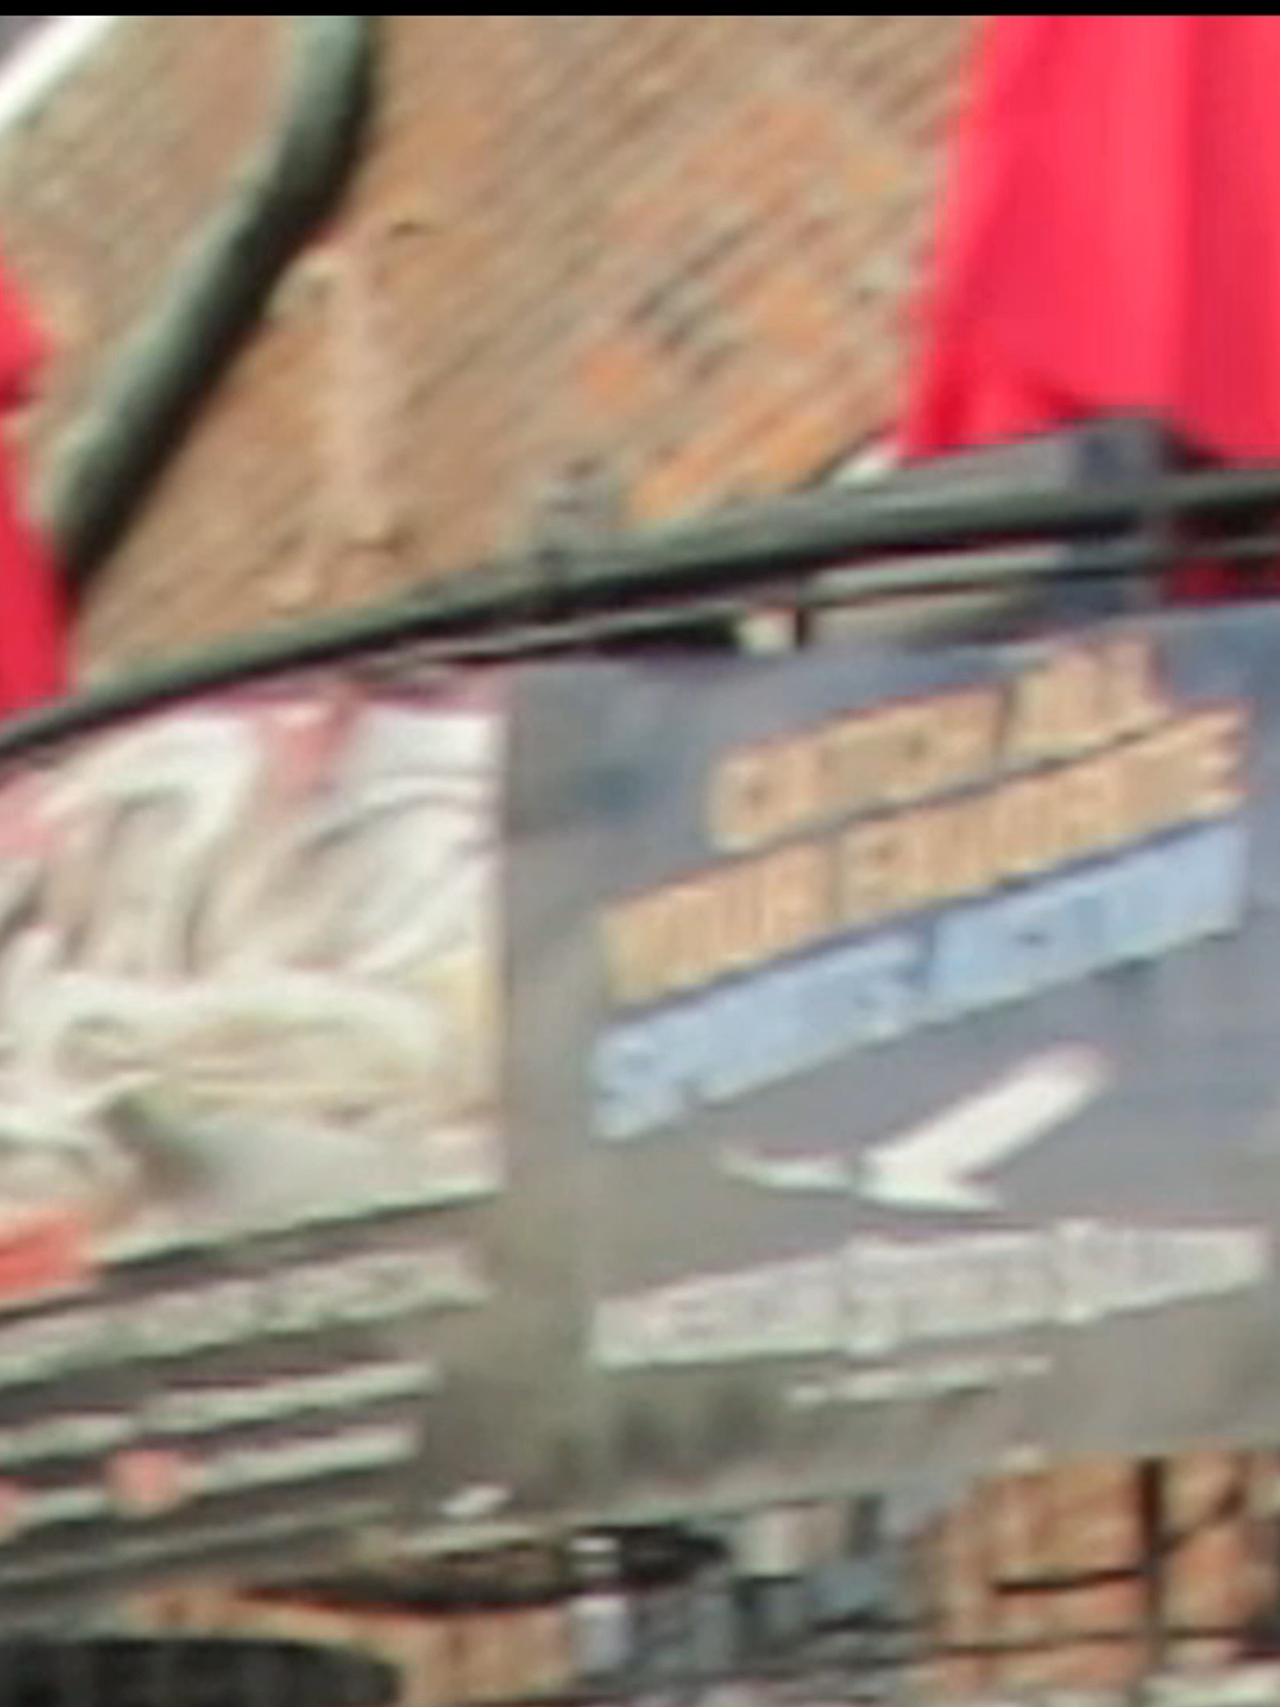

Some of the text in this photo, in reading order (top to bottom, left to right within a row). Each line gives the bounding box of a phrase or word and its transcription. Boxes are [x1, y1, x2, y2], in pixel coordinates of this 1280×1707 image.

[600, 698, 1250, 1008] YOUR FAVORITE
[706, 632, 1170, 856] CATCH ALL
[588, 928, 926, 1142] SPORTS
